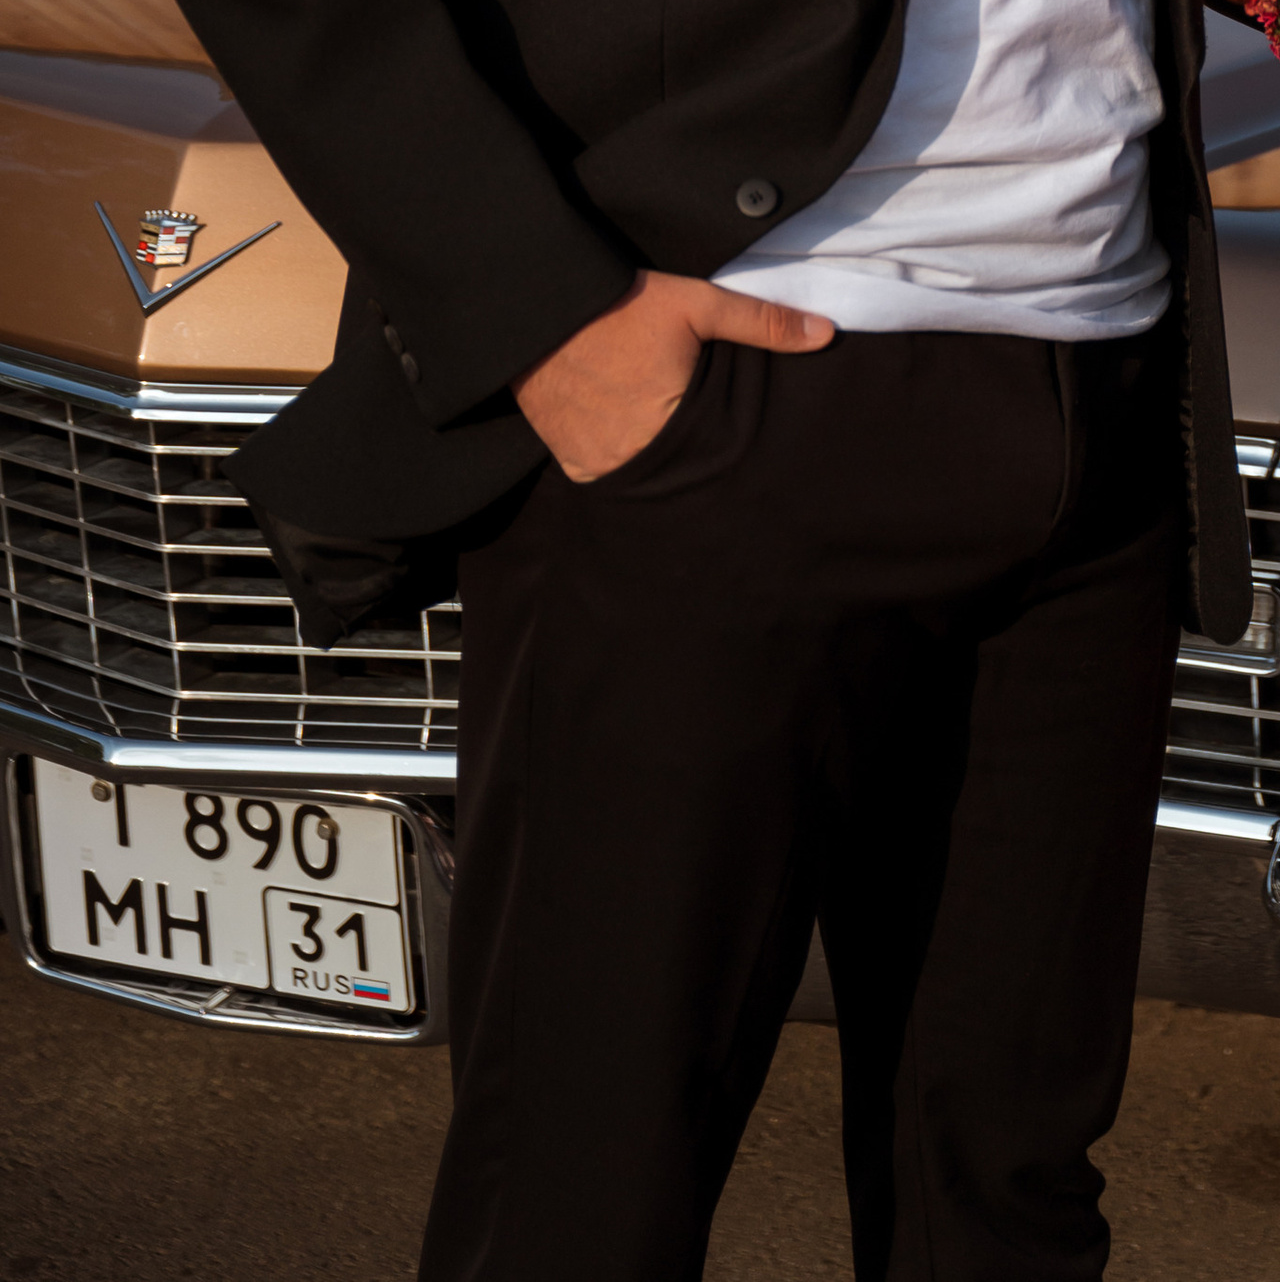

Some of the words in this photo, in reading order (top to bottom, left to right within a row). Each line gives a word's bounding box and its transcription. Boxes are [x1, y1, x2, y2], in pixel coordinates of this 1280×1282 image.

[185, 792, 338, 881] 890
[83, 869, 212, 966] MH
[288, 902, 369, 972] 31
[292, 967, 351, 995] RUS
